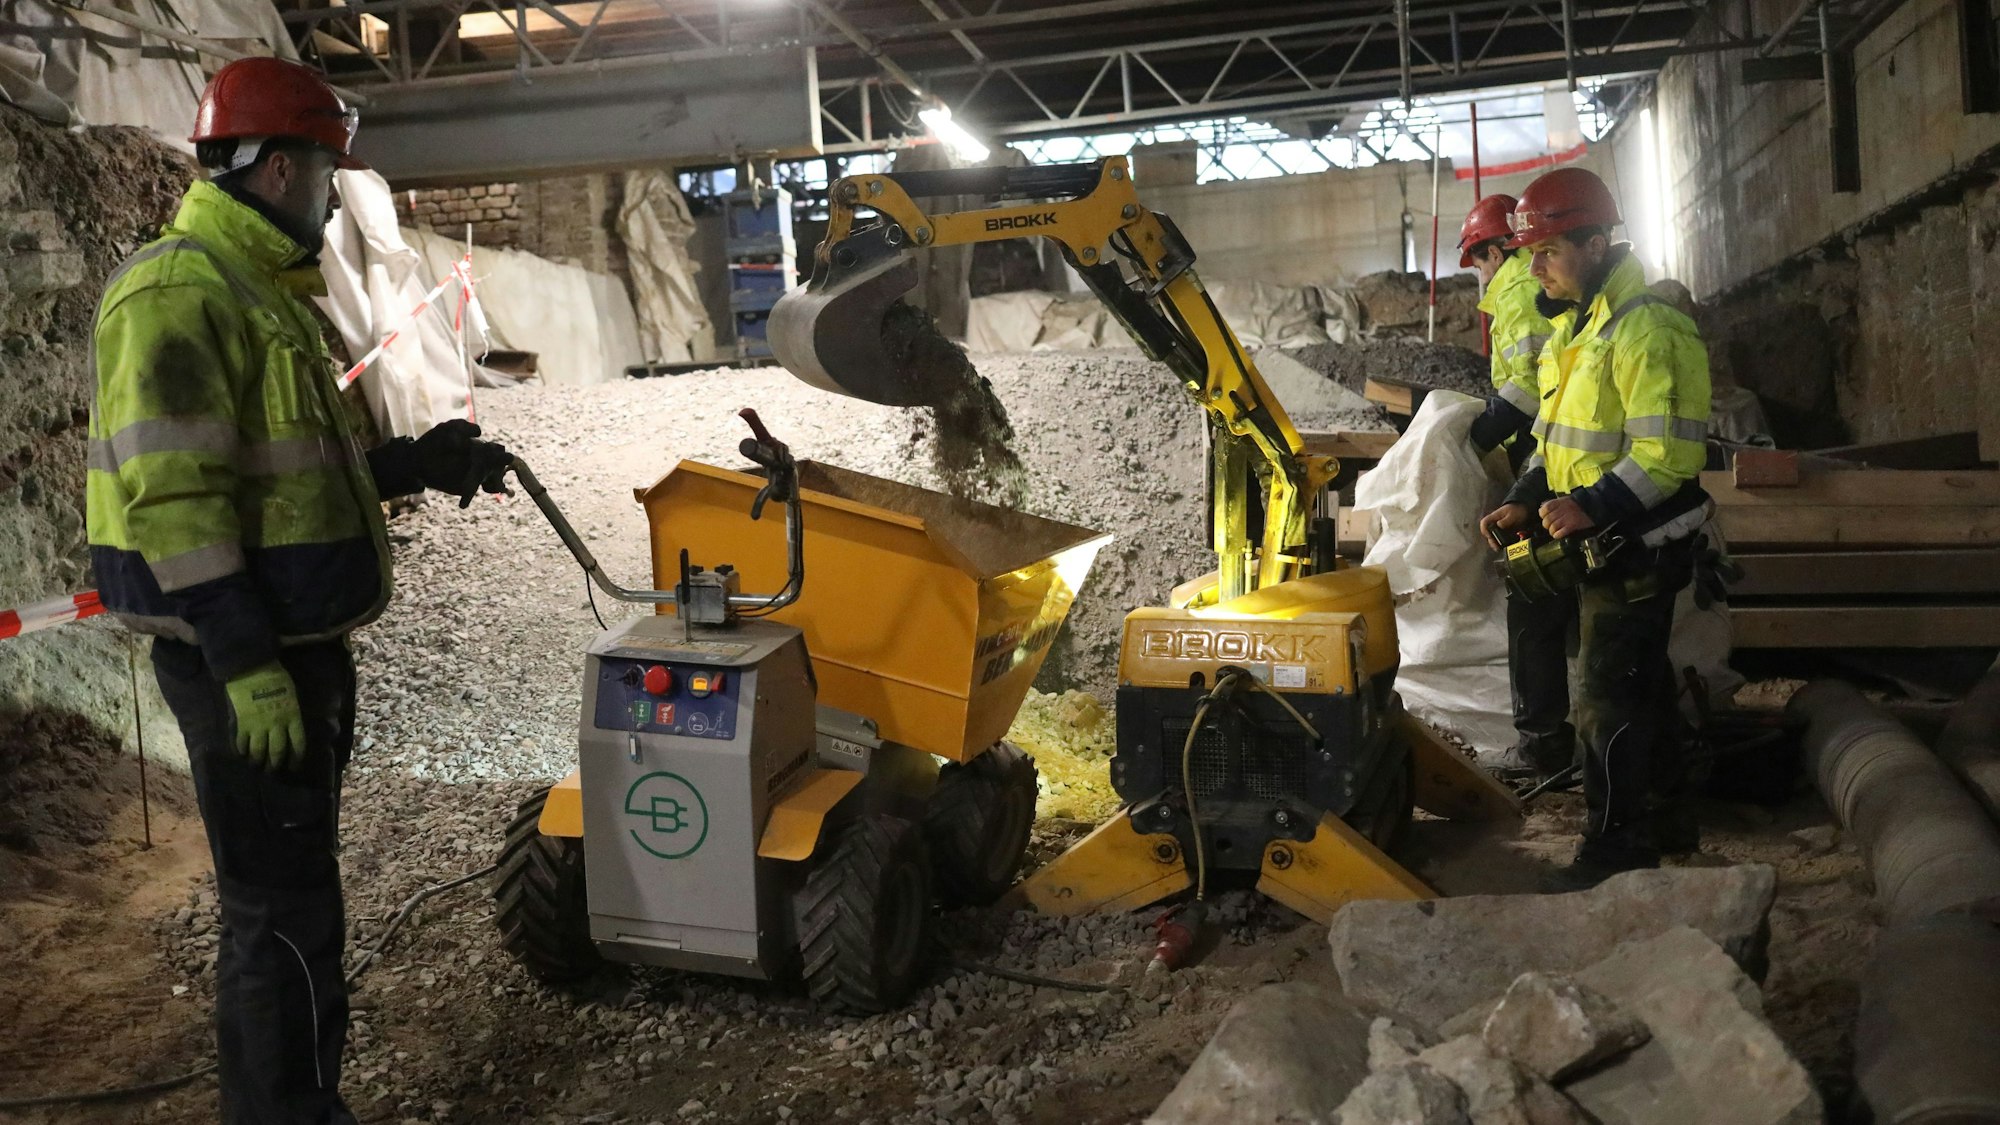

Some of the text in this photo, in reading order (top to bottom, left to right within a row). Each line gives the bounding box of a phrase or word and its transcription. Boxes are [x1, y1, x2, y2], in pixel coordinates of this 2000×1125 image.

[985, 212, 1057, 231] BROKK
[1508, 544, 1528, 556] BROKK
[1140, 629, 1329, 662] BROKK
